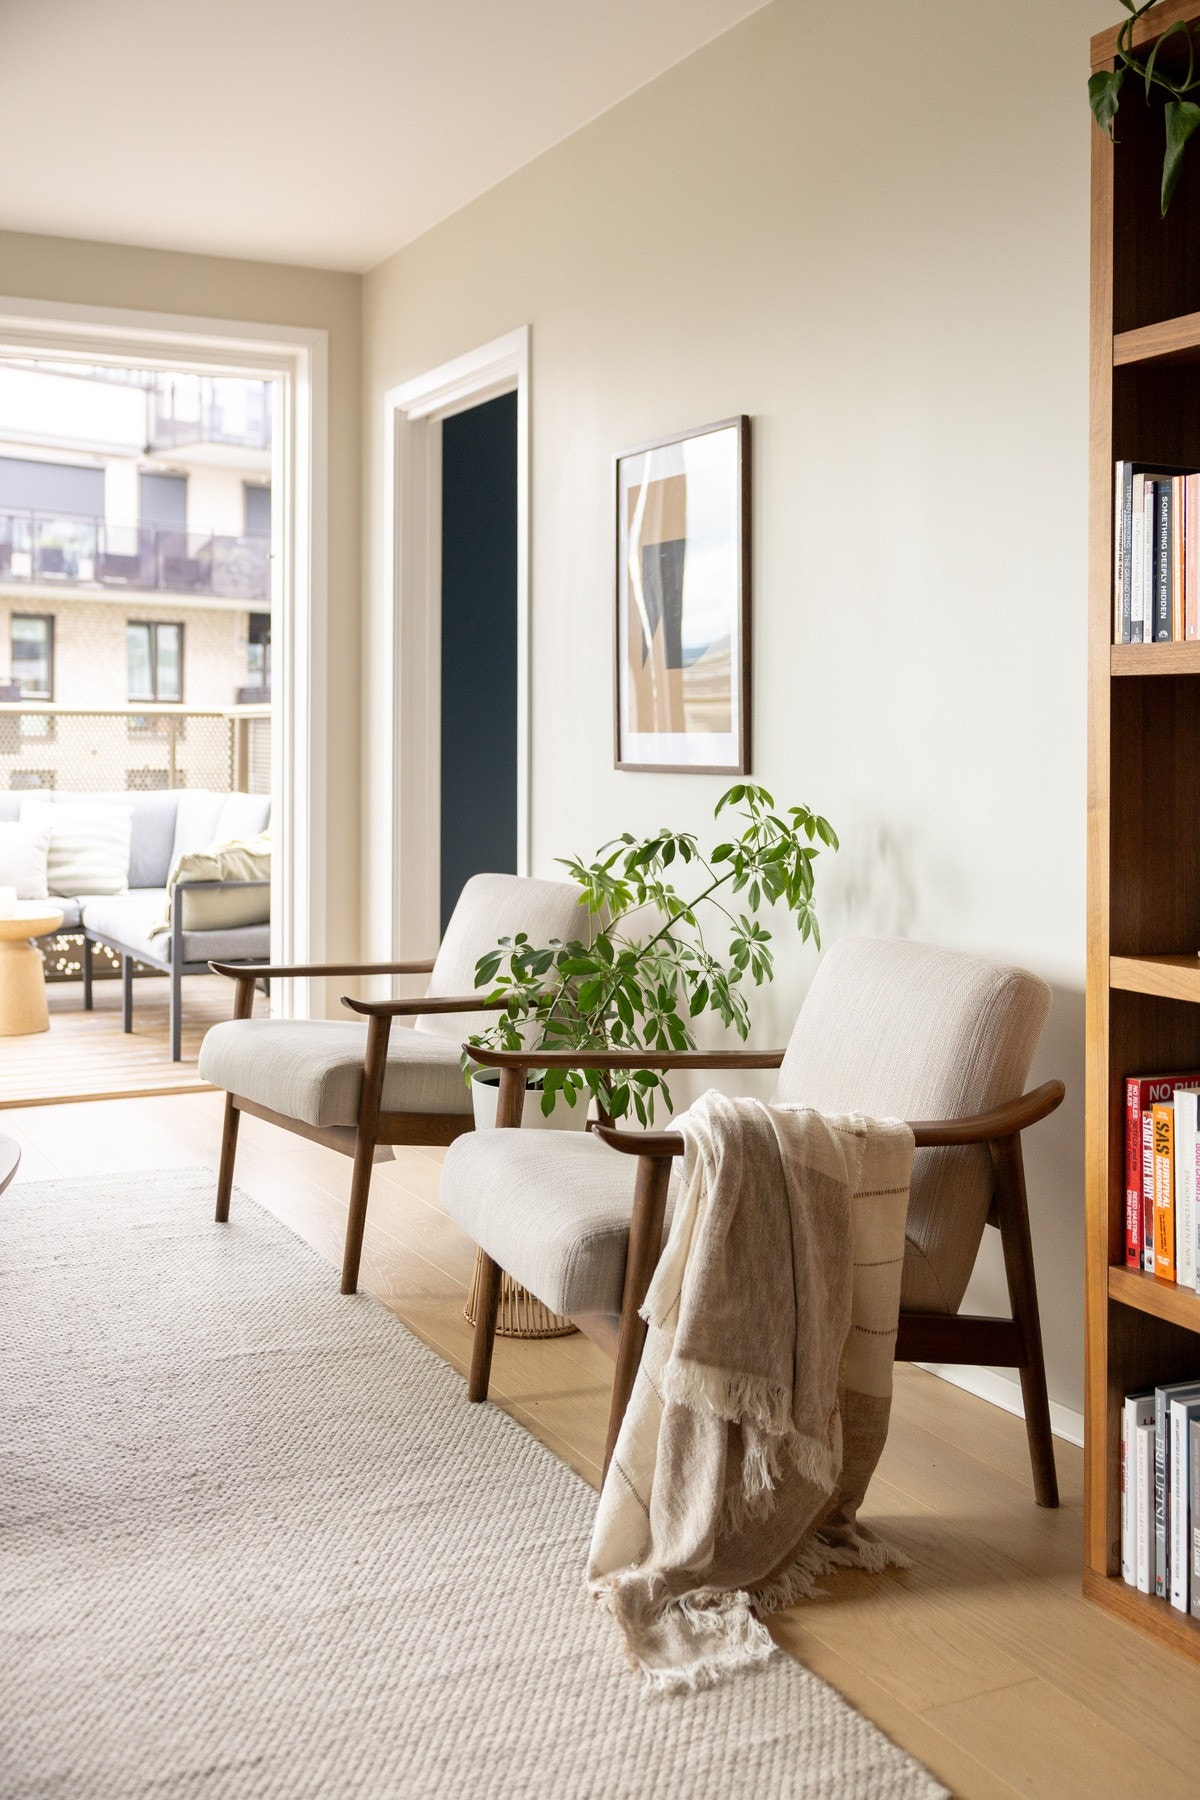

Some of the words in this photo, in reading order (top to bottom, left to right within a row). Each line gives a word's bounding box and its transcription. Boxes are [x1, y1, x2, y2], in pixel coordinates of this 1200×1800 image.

[1160, 552, 1168, 584] DEEPLY
[1160, 586, 1168, 619] HIDDEN
[1132, 1085, 1138, 1096] NO
[1150, 1083, 1171, 1101] NO
[1143, 1117, 1153, 1148] START
[1156, 1121, 1170, 1155] SAS
[1143, 1149, 1153, 1174] WITH
[1144, 1176, 1154, 1201] WHY
[1162, 1157, 1170, 1209] SURVIVAL
[1155, 1437, 1165, 1542] FRILUFTSLIV
